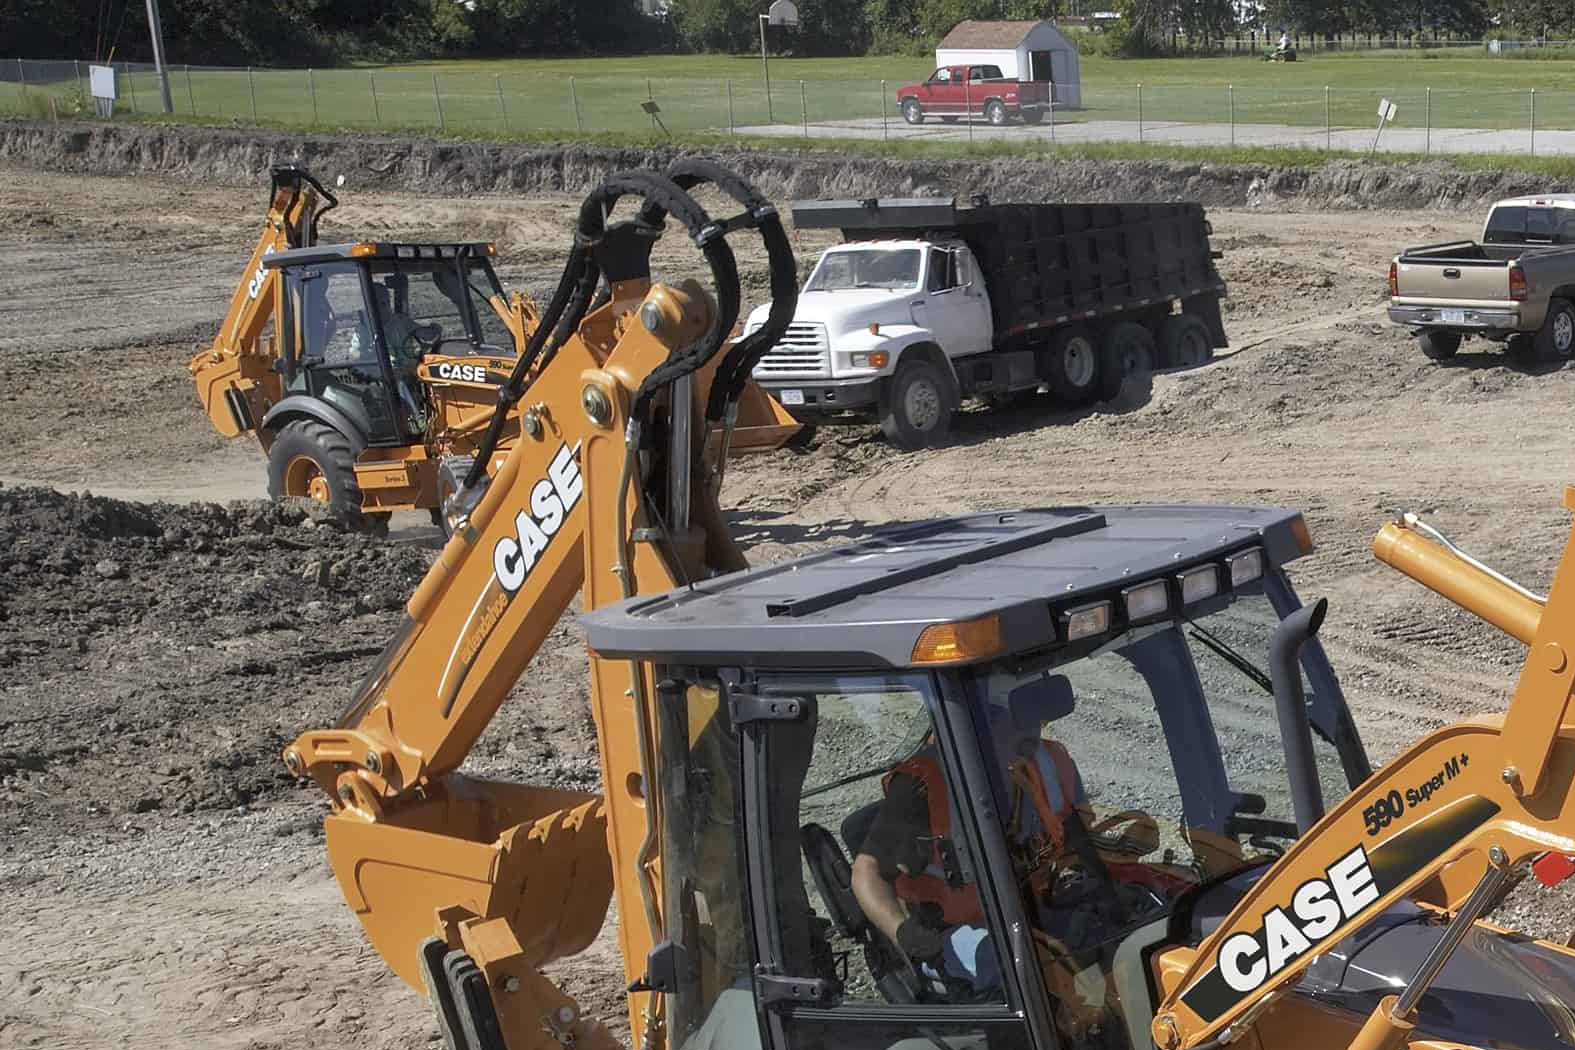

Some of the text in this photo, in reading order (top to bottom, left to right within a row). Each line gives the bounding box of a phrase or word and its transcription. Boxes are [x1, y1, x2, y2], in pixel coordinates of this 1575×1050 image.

[440, 363, 486, 382] CASE
[495, 440, 583, 591] CASE
[1362, 789, 1404, 836] 590
[1405, 771, 1444, 808] Super
[1217, 845, 1380, 992] CASE
